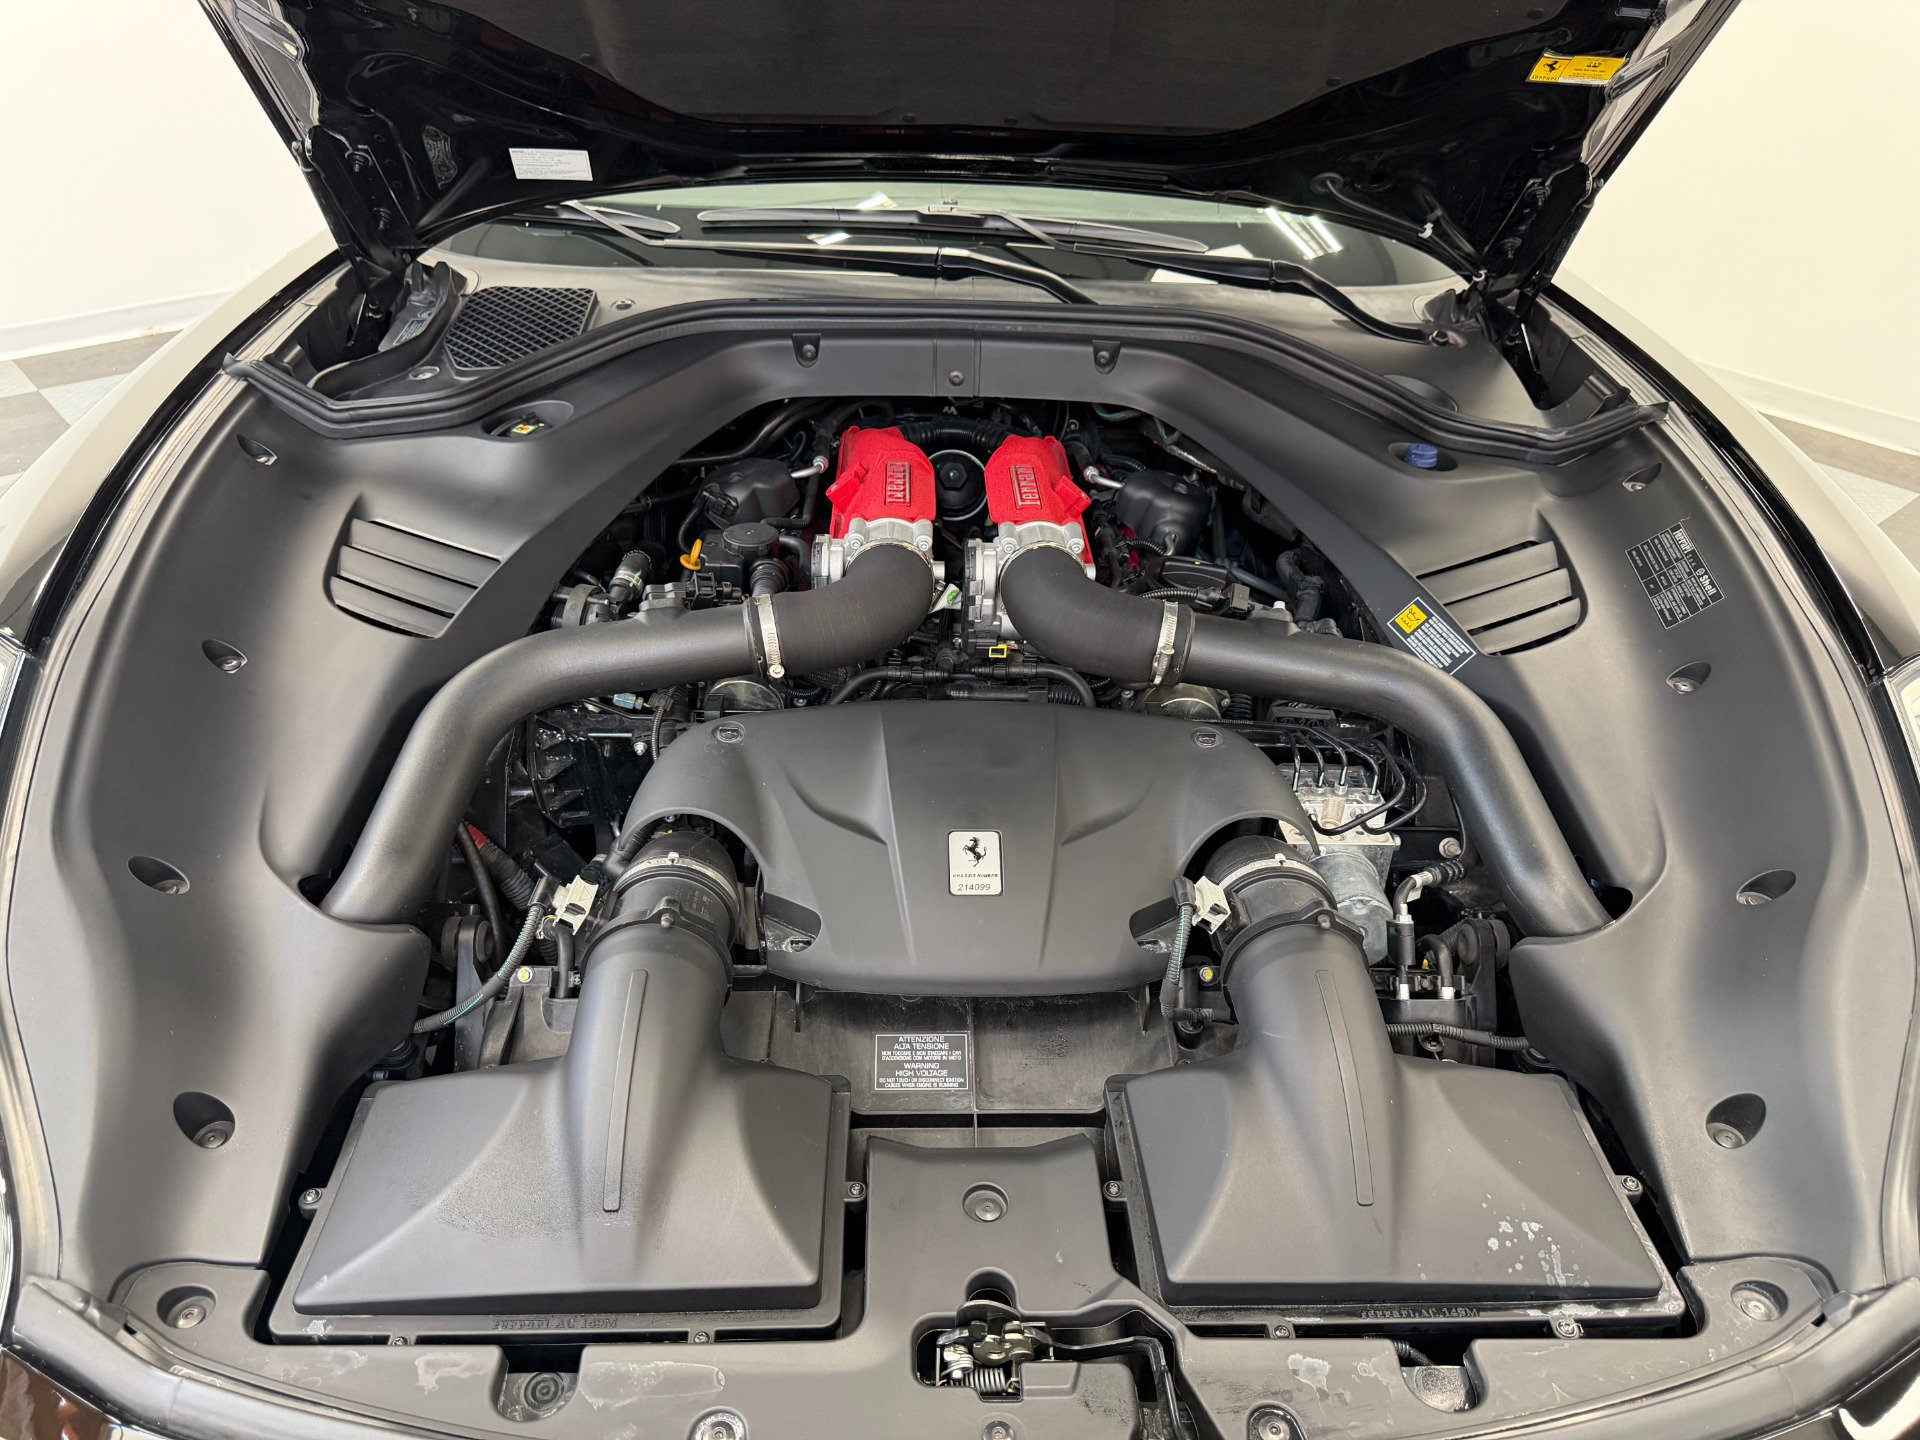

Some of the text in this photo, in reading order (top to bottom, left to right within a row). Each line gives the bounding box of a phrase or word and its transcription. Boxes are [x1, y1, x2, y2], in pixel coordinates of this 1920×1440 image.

[886, 460, 911, 506] Ferrari
[1673, 528, 1694, 555] Ferrari
[1699, 574, 1717, 596] Shell
[957, 883, 991, 891] 214099
[492, 1319, 550, 1330] Ferrari
[555, 1318, 576, 1329] AC
